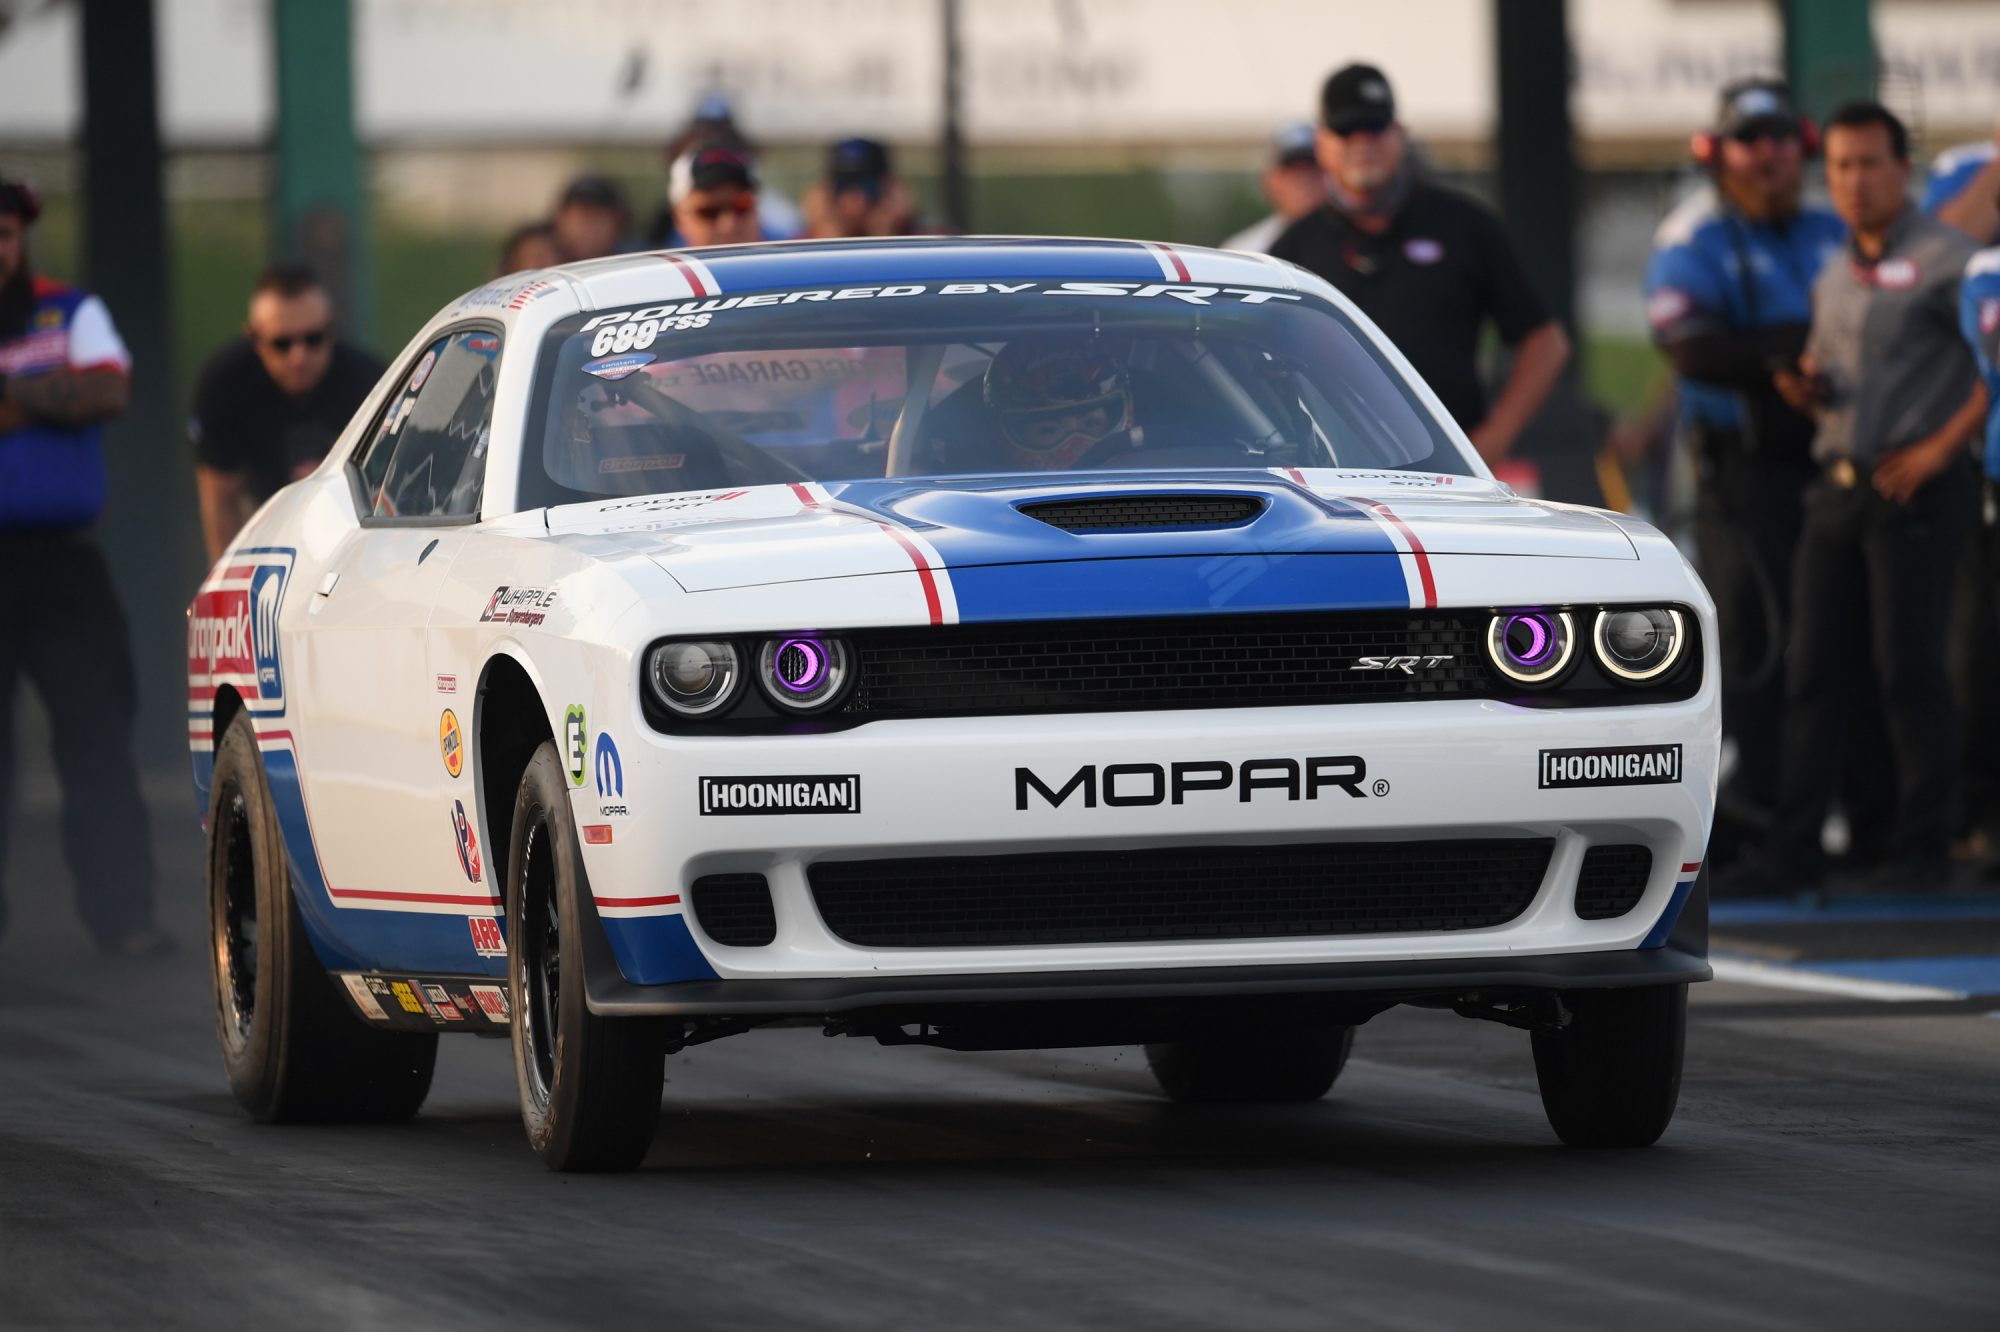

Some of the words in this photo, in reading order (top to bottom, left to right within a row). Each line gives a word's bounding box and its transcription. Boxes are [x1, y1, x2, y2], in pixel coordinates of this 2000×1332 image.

[579, 285, 927, 333] POWERED
[938, 283, 1037, 295] BY
[1042, 282, 1302, 306] SRT
[641, 502, 714, 513] SRT
[501, 589, 557, 608] WHIPPLE
[1349, 655, 1454, 675] SRT
[470, 918, 501, 950] ARP
